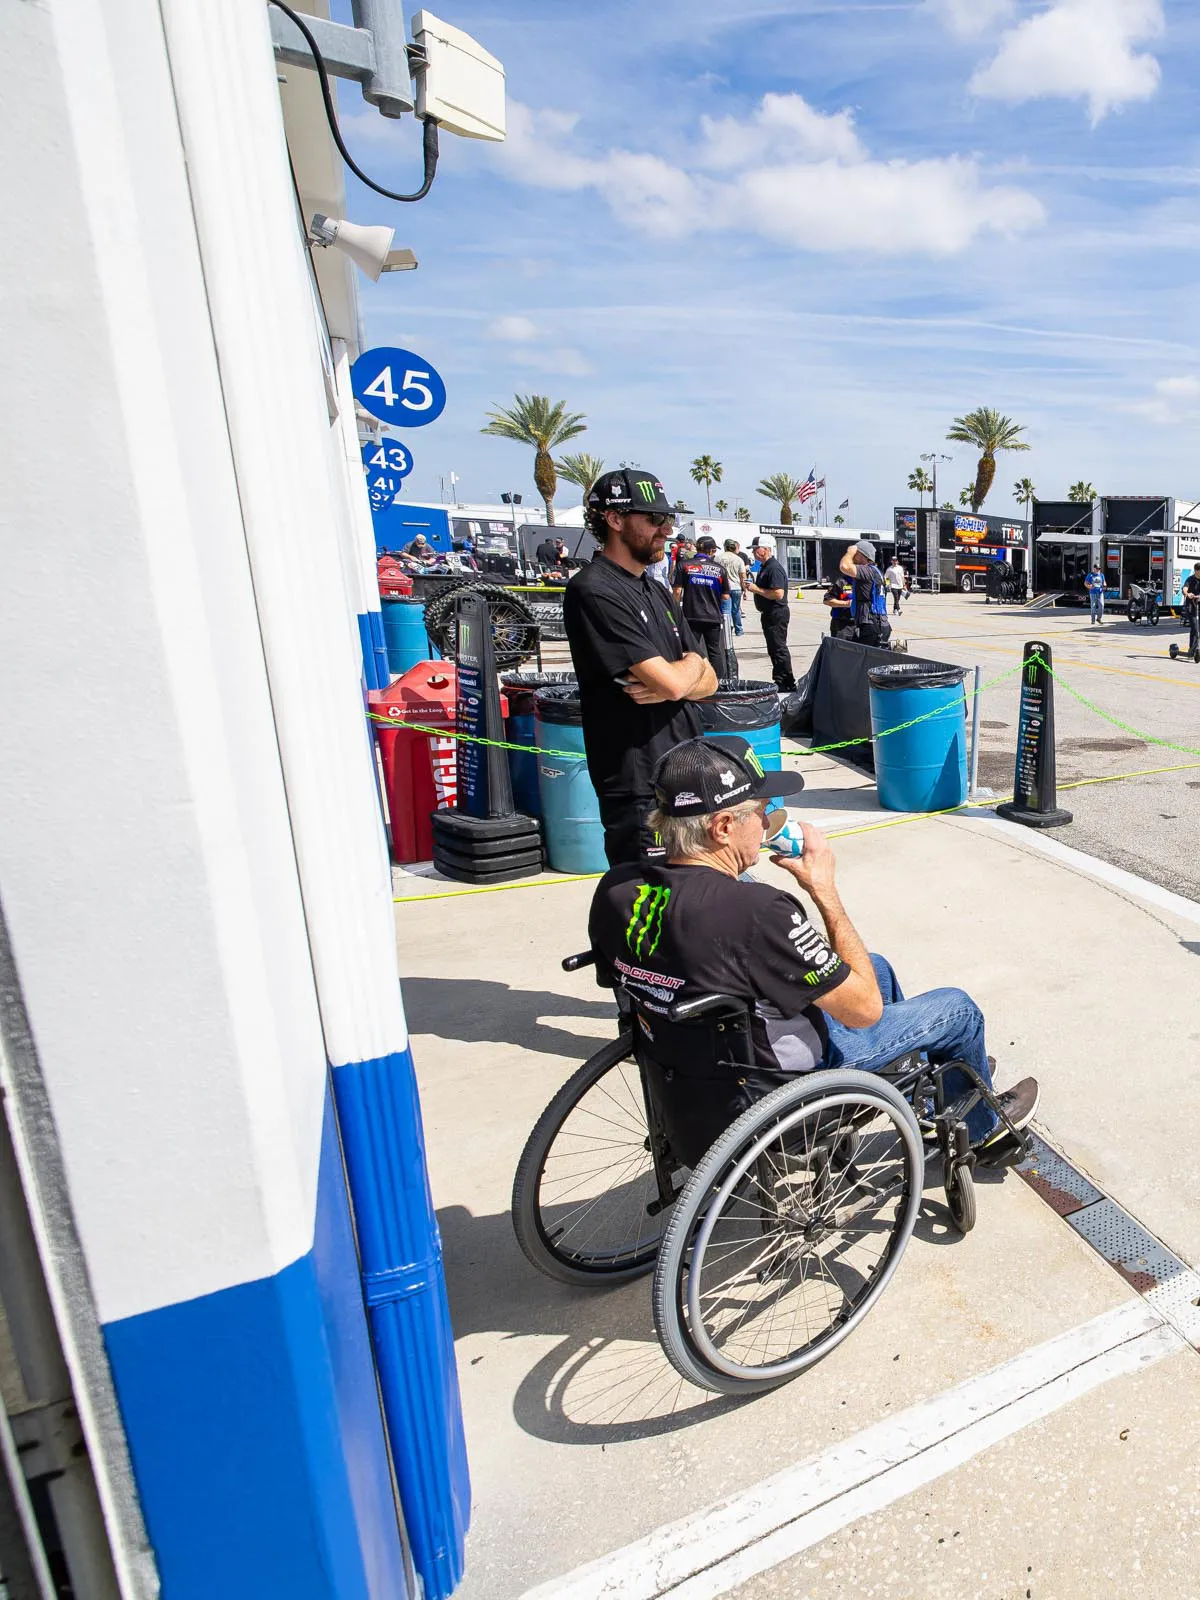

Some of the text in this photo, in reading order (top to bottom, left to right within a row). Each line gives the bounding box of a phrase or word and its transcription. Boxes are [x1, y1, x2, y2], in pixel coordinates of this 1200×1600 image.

[363, 365, 434, 411] 45
[369, 447, 408, 471] 43
[373, 476, 394, 490] 41
[761, 526, 793, 534] Restrooms
[1181, 544, 1197, 552] TOOL
[720, 783, 752, 799] SCOTT
[630, 967, 686, 990] CIRCUIT
